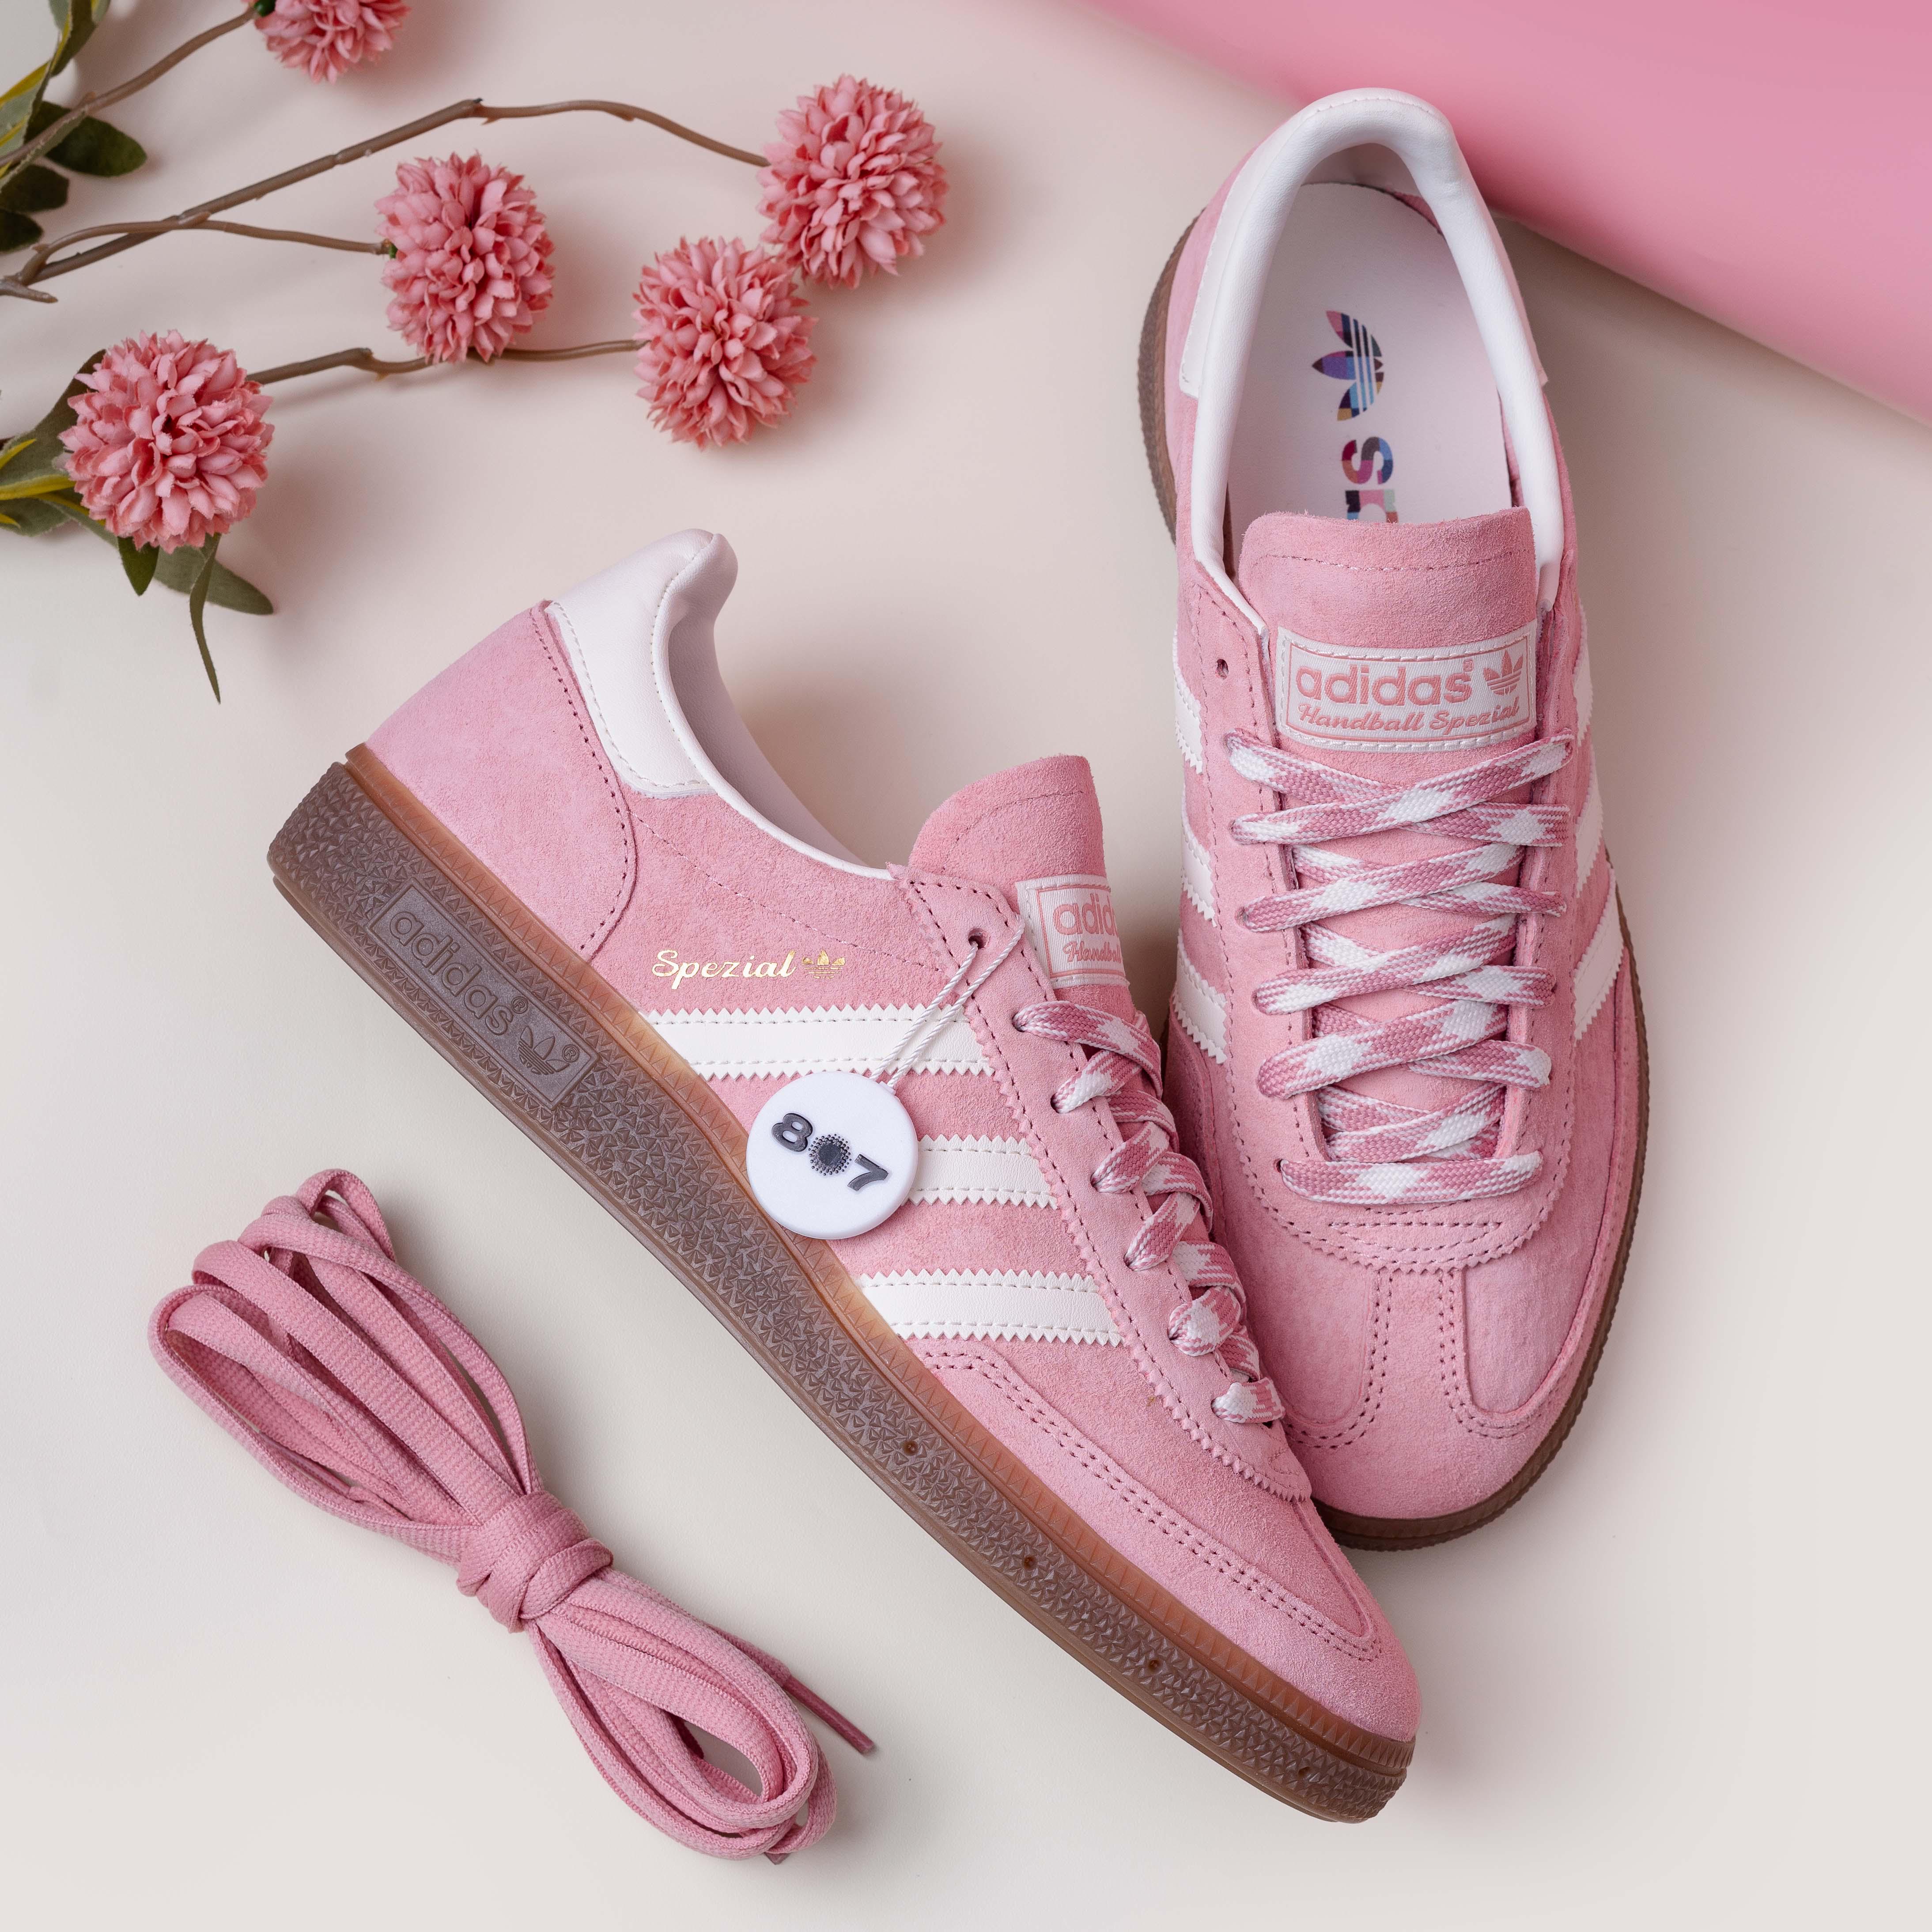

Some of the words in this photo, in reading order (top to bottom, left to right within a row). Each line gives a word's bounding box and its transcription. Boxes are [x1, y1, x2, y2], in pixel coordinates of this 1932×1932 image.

[1298, 704, 1425, 731] Handball
[1429, 698, 1520, 734] Spezial
[1053, 893, 1119, 936] adid
[651, 949, 797, 990] Spezial
